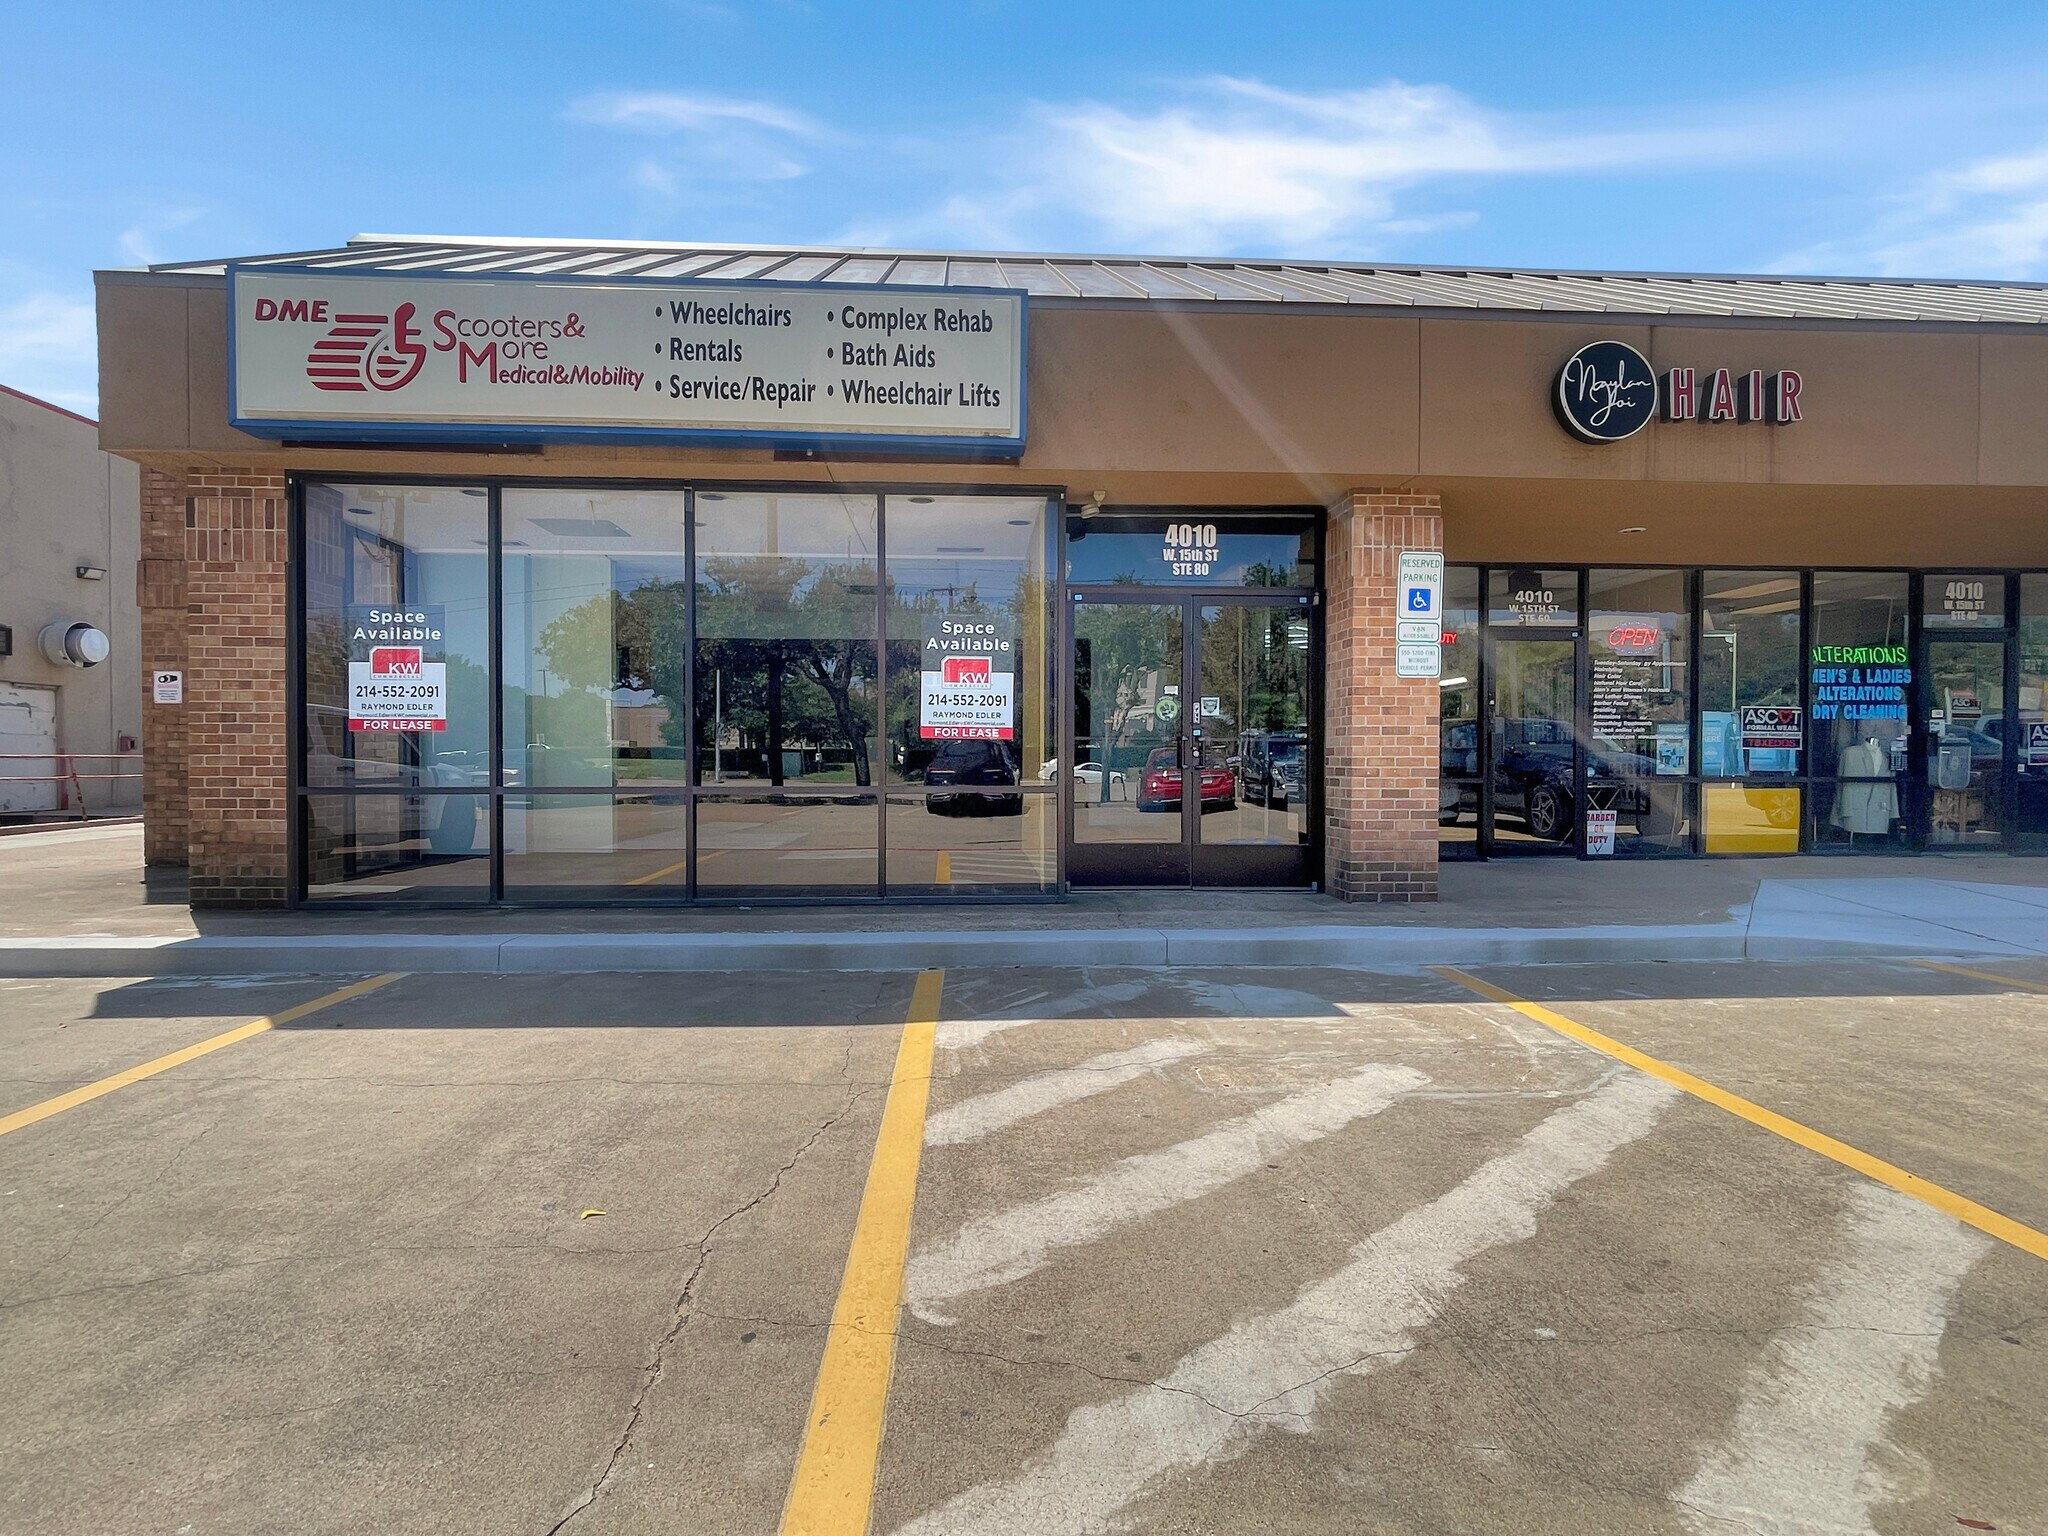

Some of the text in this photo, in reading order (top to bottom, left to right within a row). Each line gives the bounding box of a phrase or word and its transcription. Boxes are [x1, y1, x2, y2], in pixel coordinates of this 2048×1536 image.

[254, 298, 329, 323] DME
[669, 301, 792, 327] Wheelchairs
[841, 305, 993, 336] Complex Rehab
[669, 337, 743, 362] Rentals
[841, 342, 936, 369] Bath Aids
[669, 374, 816, 409] Service/Repair
[841, 379, 1001, 408] Wheelchair Lifts
[1669, 367, 1803, 421] HAIR
[1164, 524, 1217, 548] 4010
[1162, 549, 1219, 561] W. 15th ST
[1172, 563, 1209, 576] STE 80
[1402, 559, 1440, 569] RESERVED
[1403, 573, 1438, 583] PARKING
[1515, 590, 1553, 603] 4010
[1945, 581, 1984, 600] 4010
[1521, 605, 1546, 613] 15TH
[1548, 605, 1560, 613] ST
[1974, 600, 1985, 610] ST
[369, 610, 425, 625] Space
[1518, 614, 1535, 623] STE
[1950, 611, 1966, 621] STE
[353, 627, 442, 641] Available
[942, 621, 995, 636] Space
[1608, 628, 1658, 647] OPEN
[926, 638, 1010, 651] Available
[388, 662, 418, 675] KW
[959, 672, 988, 684] KW
[1852, 668, 1861, 684] &
[1866, 668, 1912, 684] LADIES
[356, 685, 439, 698] 214-552-2091
[1817, 686, 1903, 701] ALTERATIONS
[361, 703, 404, 711] RAYMOND
[928, 694, 1007, 707] 214-552-2091
[932, 711, 974, 719] RAYMOND
[1812, 704, 1907, 719] DRY CLEANING
[363, 720, 432, 730] FOR LEASE
[934, 728, 1000, 738] FOR LEASE
[1587, 813, 1615, 821] BARBER
[1588, 835, 1609, 844] DUTY
